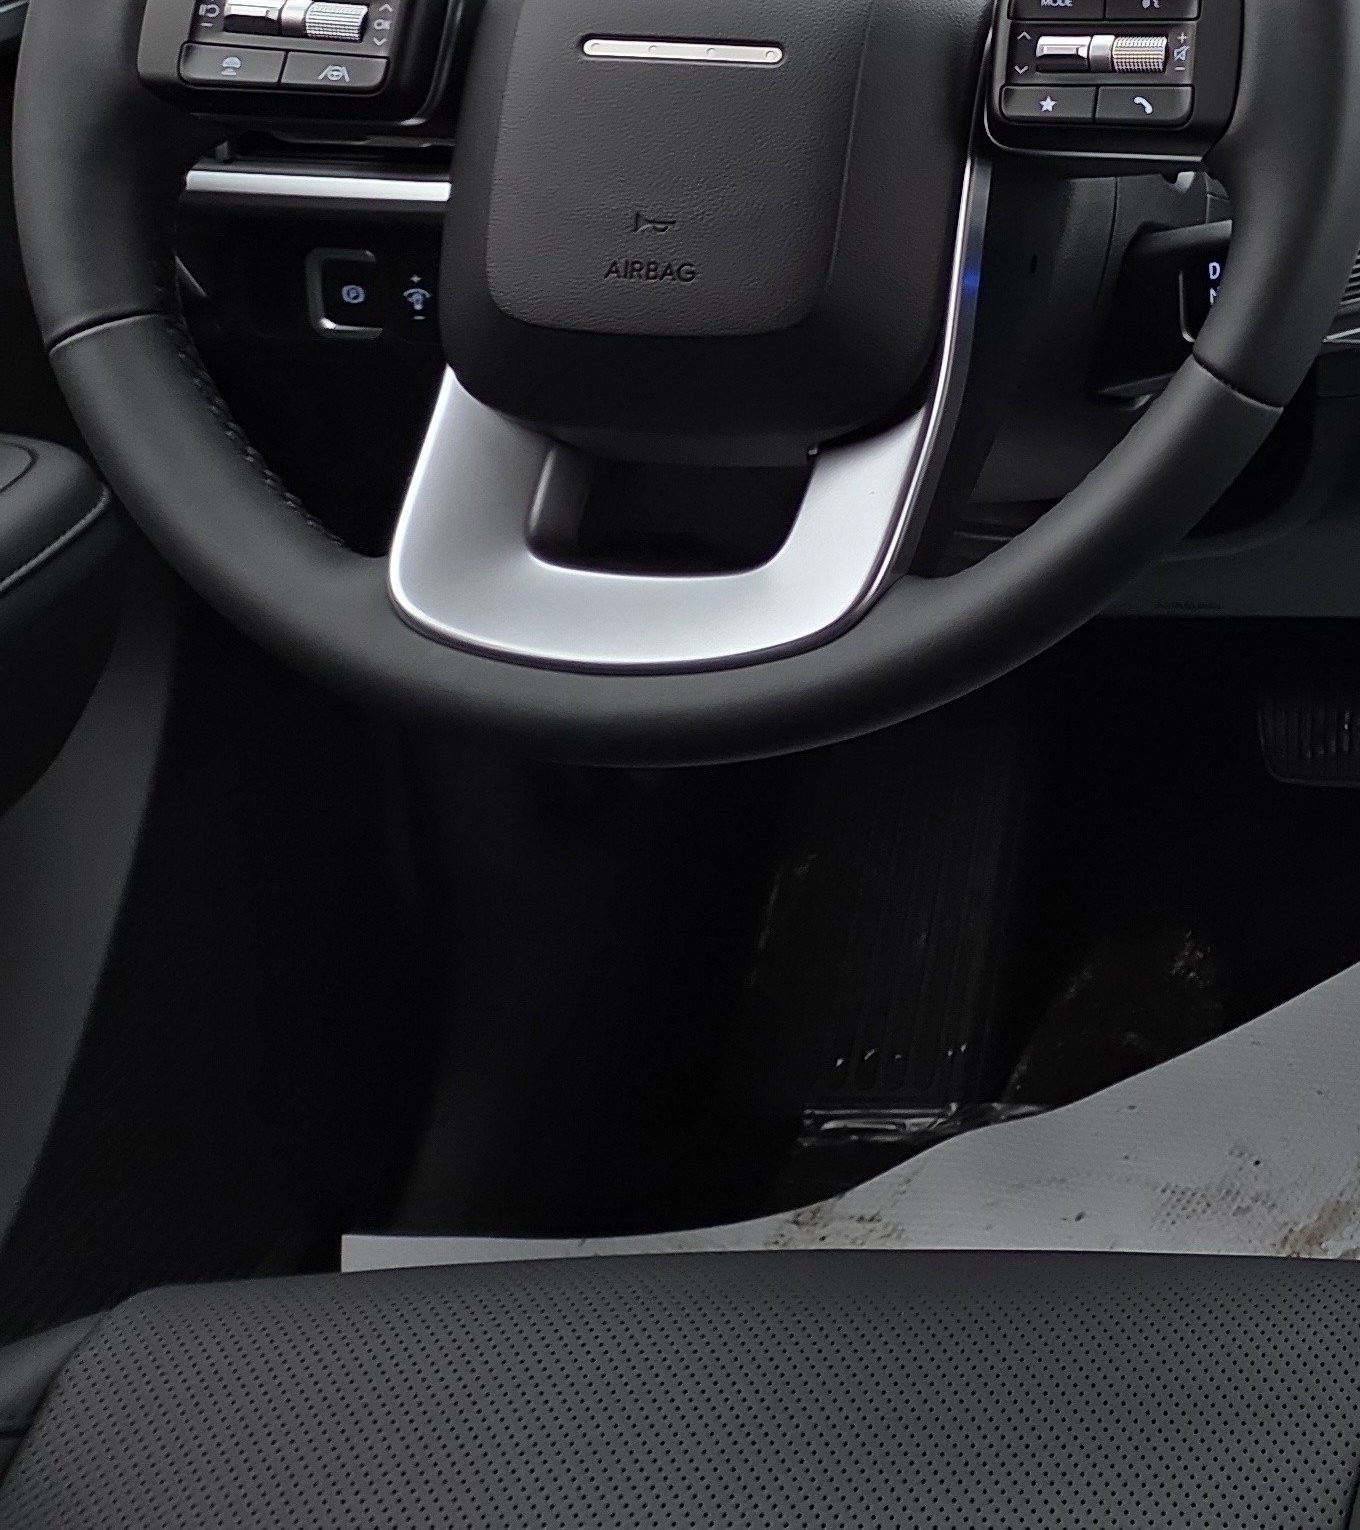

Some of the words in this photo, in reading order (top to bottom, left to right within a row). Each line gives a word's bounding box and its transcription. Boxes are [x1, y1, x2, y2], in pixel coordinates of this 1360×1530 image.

[373, 18, 391, 30] OK
[603, 259, 698, 283] AIRBAG
[1208, 261, 1221, 280] D
